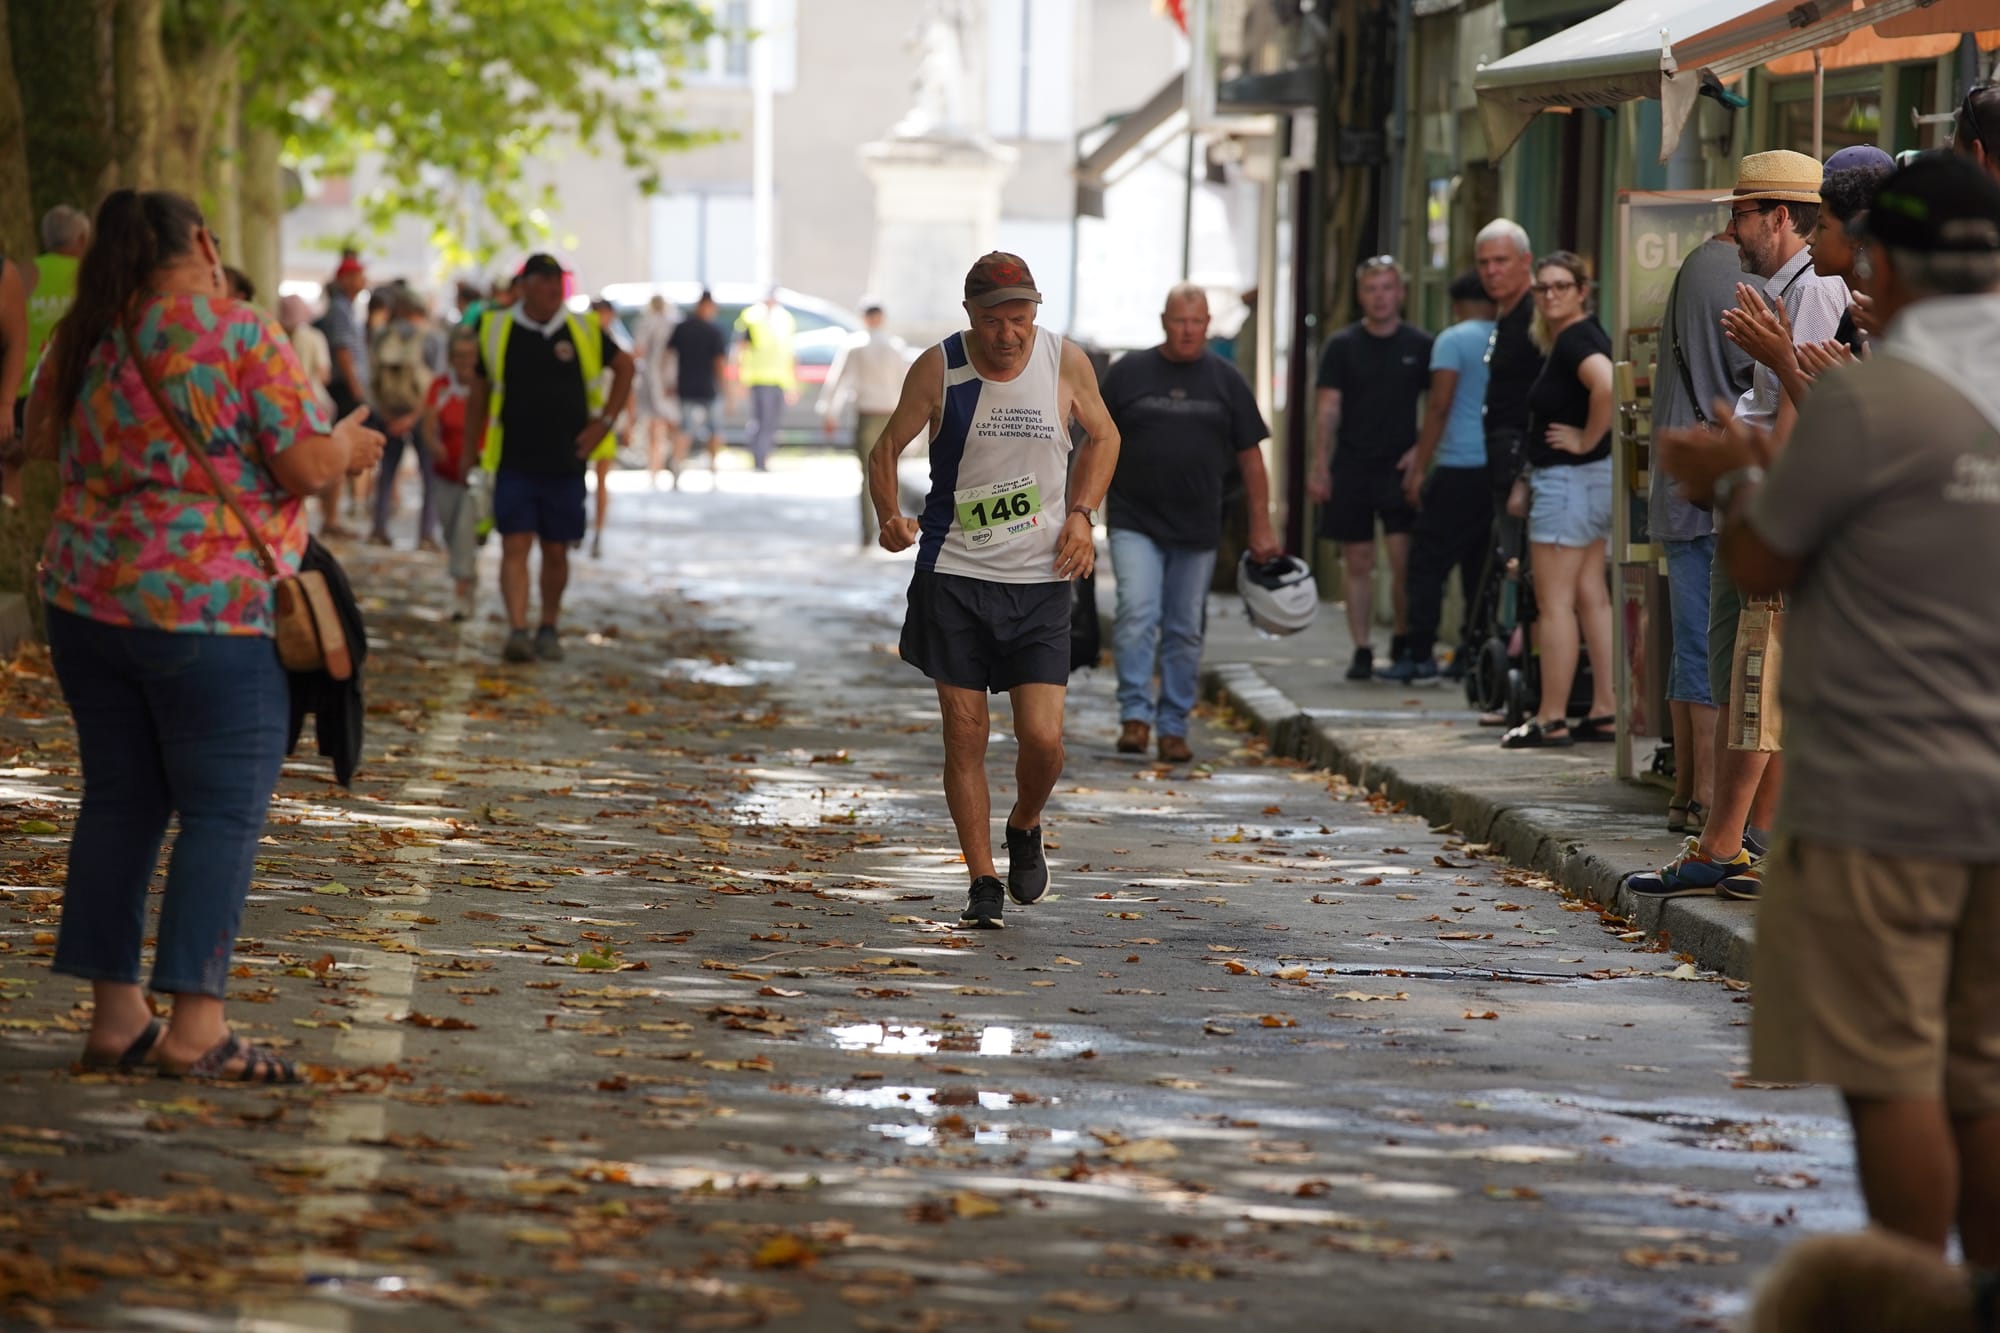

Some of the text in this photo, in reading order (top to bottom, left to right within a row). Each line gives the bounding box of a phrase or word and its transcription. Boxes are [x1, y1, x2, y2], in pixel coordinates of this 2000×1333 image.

[1005, 408, 1041, 416] LANGOGNE
[1004, 416, 1043, 424] MARVEJOLS
[971, 492, 1031, 527] 146
